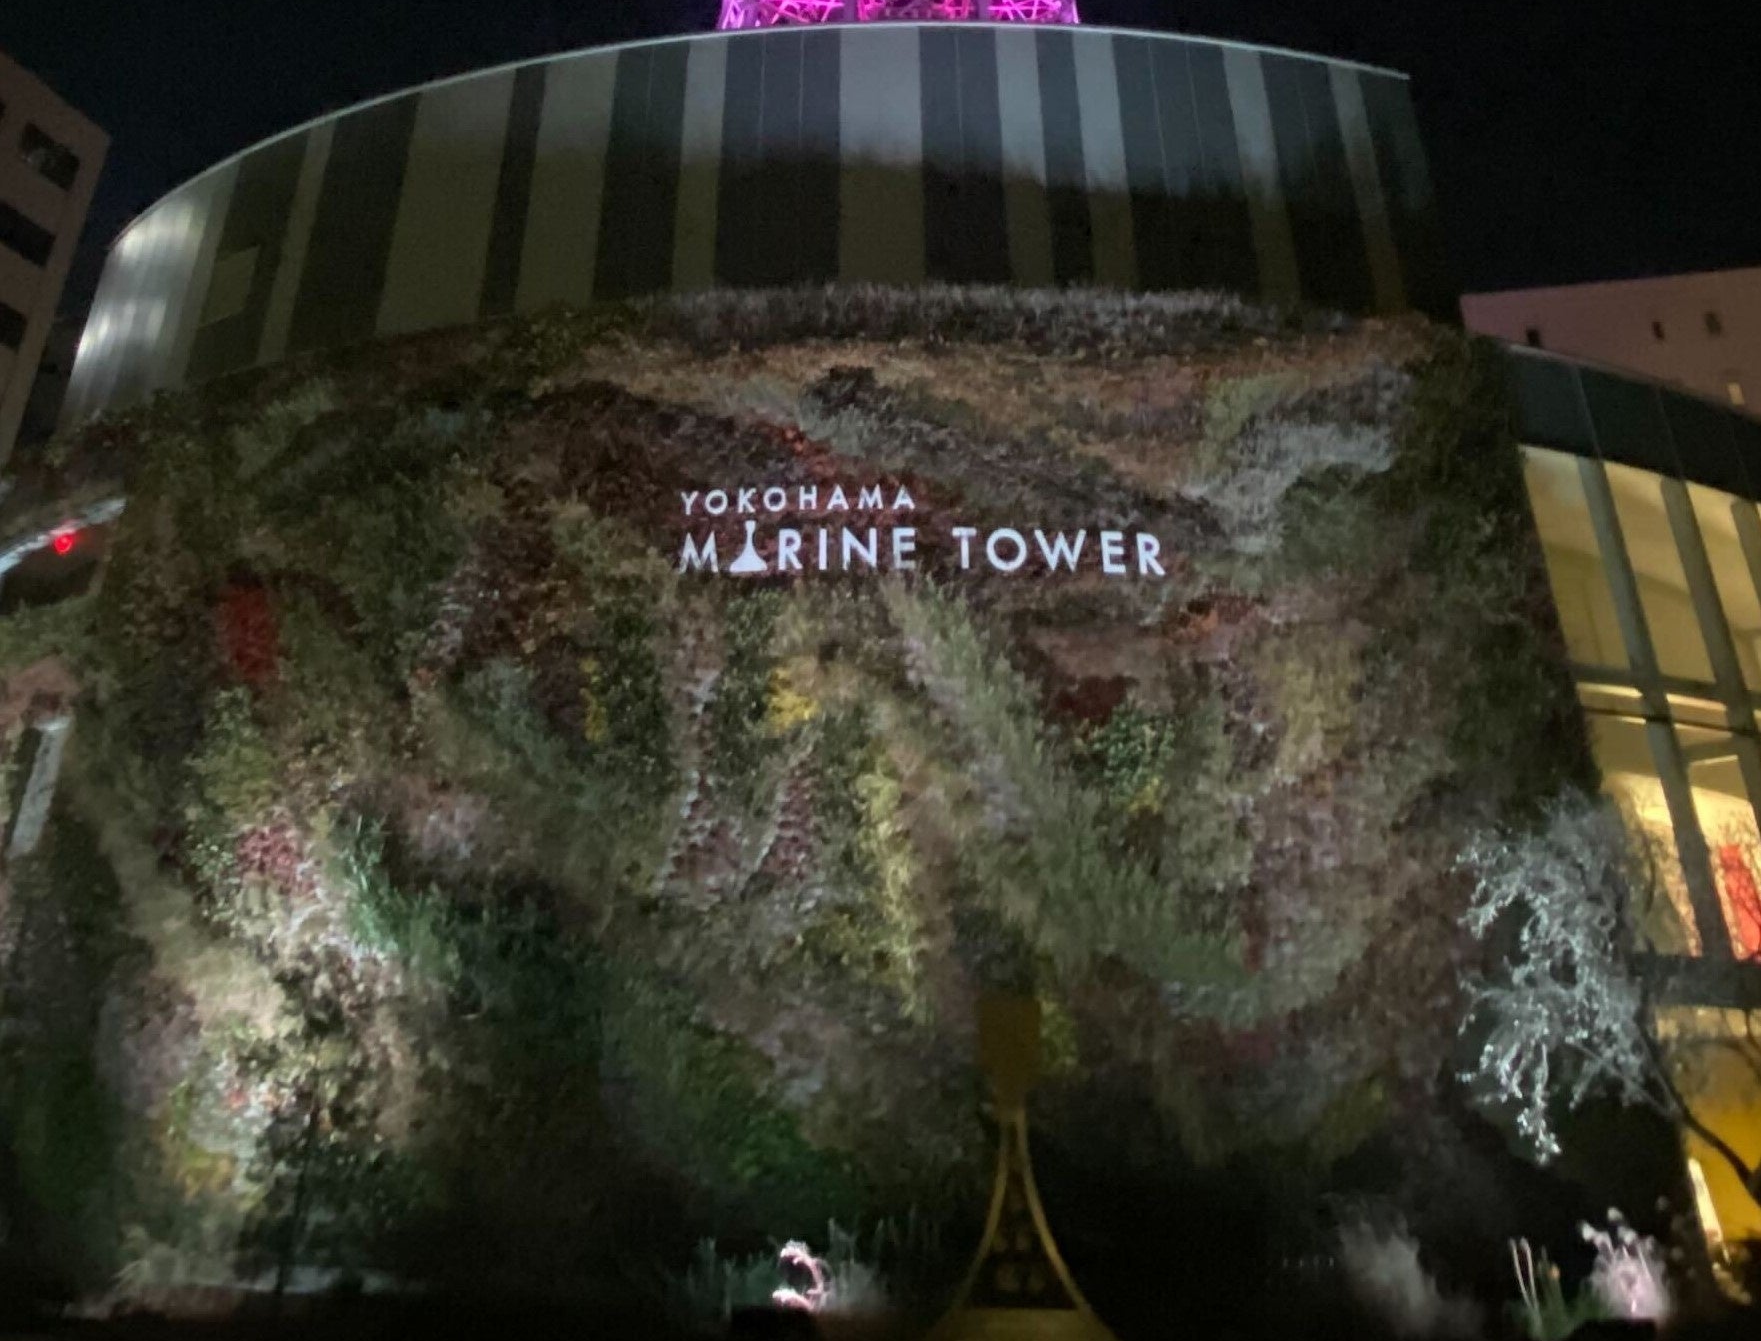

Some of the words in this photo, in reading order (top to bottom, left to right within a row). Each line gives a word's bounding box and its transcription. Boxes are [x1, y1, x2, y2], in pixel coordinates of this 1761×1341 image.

[681, 485, 916, 516] YOKOHAMA
[679, 521, 917, 574] MARINE
[952, 528, 1166, 577] TOWER
